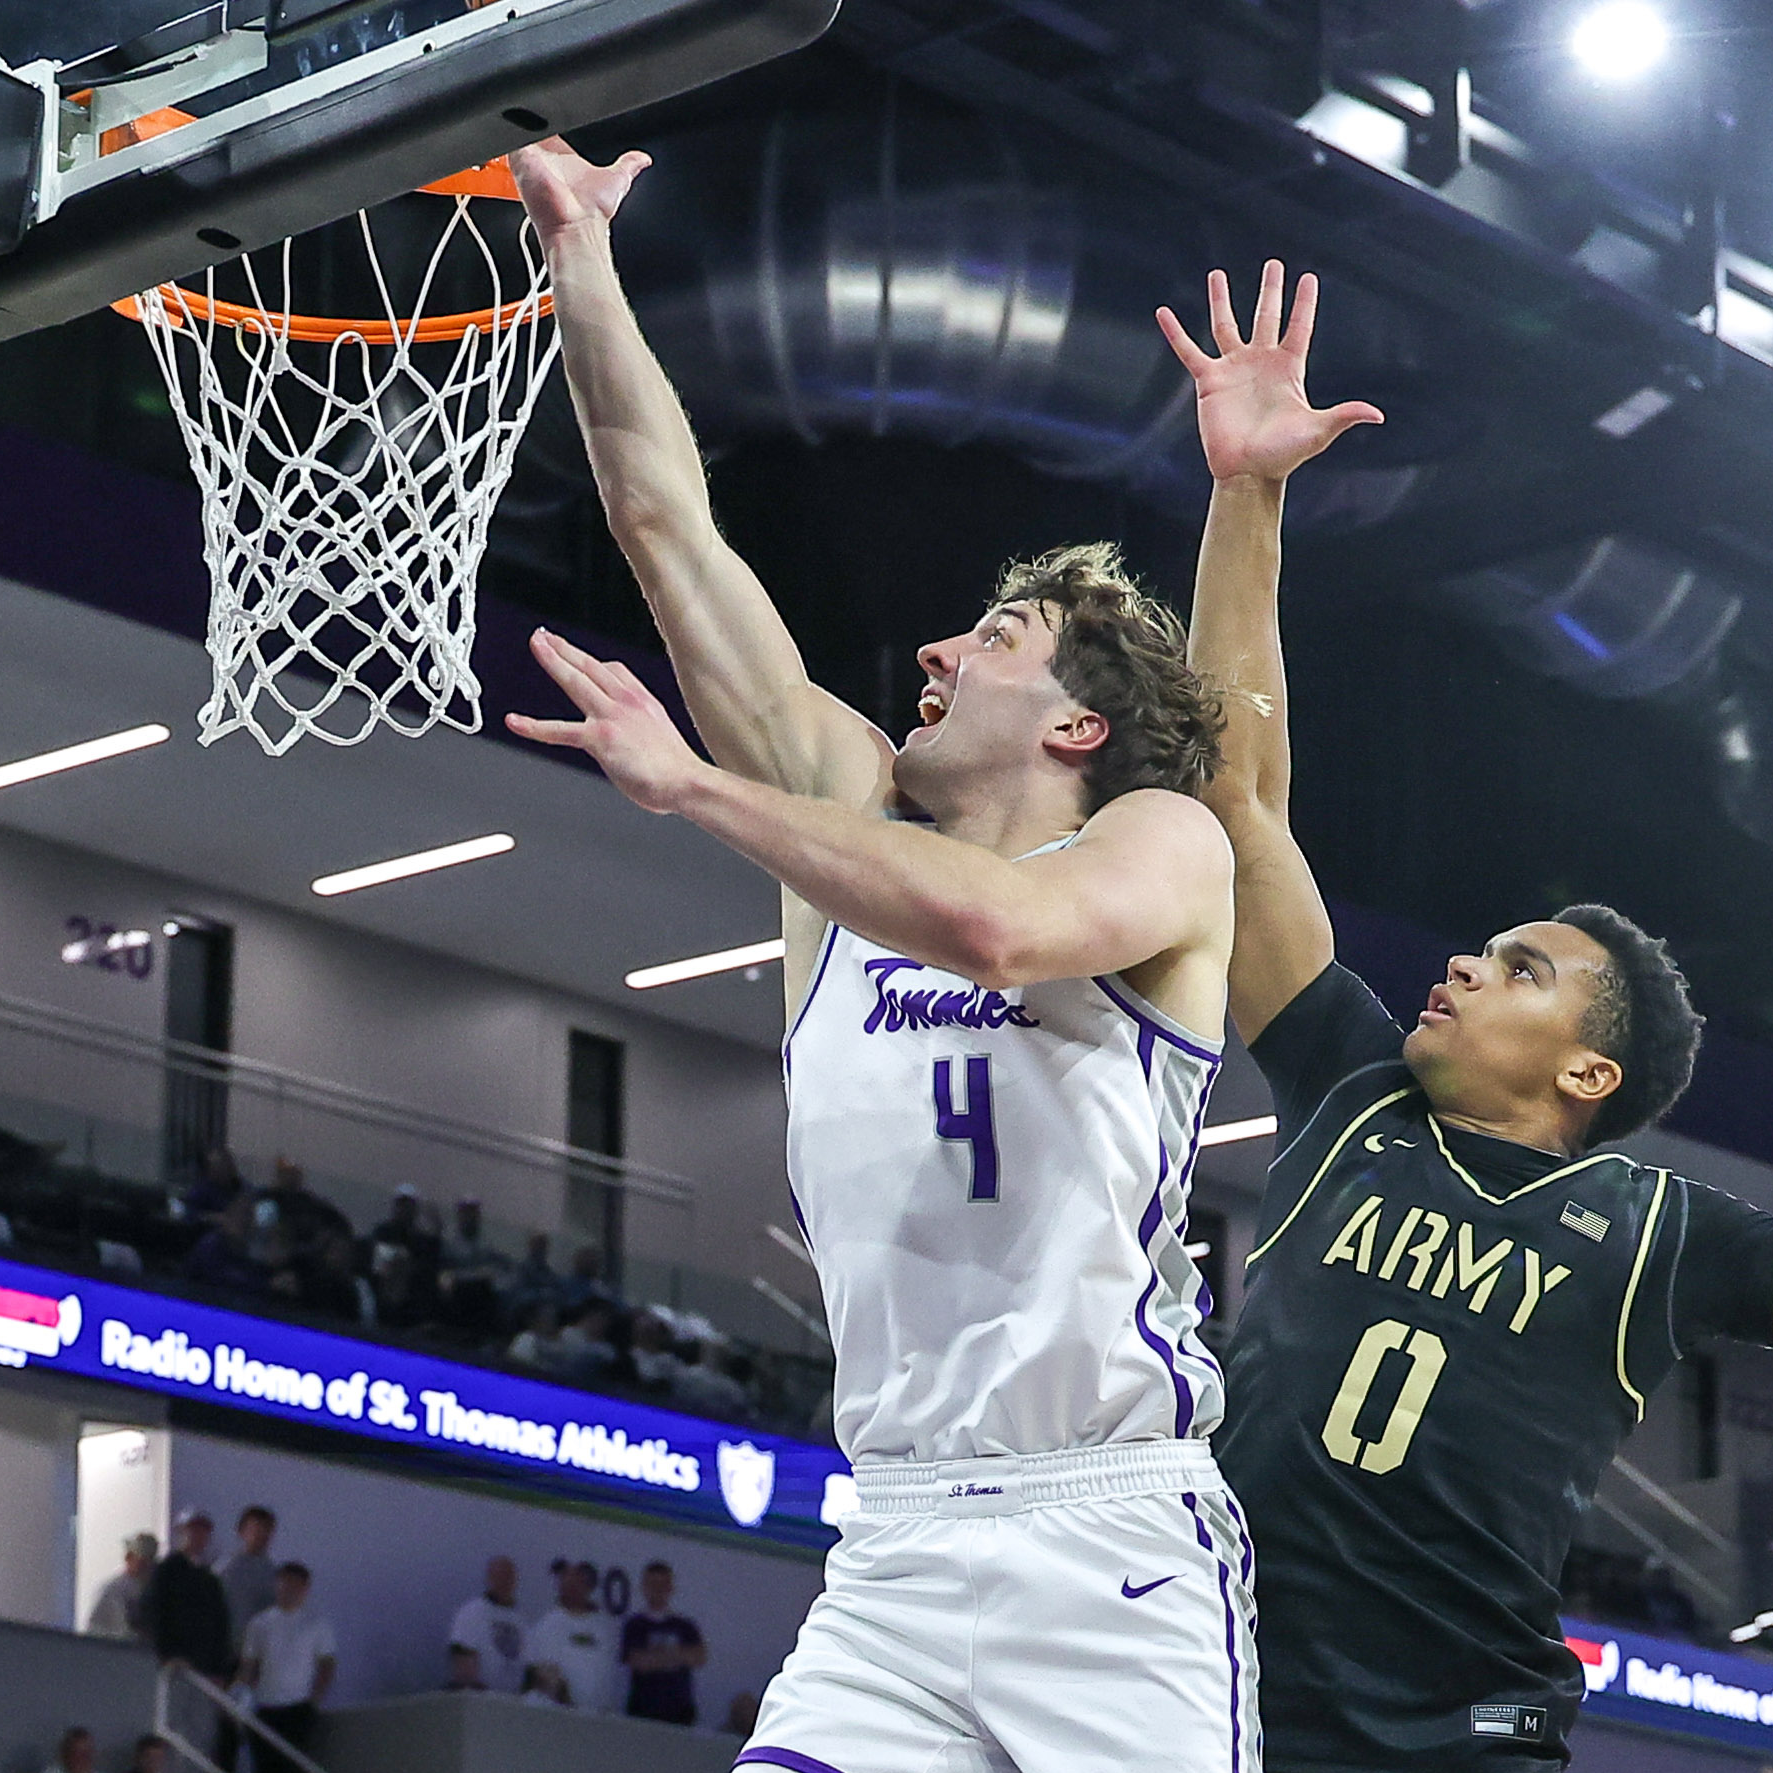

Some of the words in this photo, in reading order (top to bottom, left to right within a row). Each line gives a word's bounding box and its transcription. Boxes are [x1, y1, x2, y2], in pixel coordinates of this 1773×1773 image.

[864, 957, 1041, 1035] Tommies
[931, 1053, 1000, 1203] 4
[1322, 1193, 1572, 1335] ARMY
[101, 1318, 211, 1385] Radio
[213, 1344, 323, 1410] Home
[325, 1371, 369, 1419] of
[368, 1379, 417, 1432] St.
[419, 1389, 557, 1462] Thomas
[557, 1421, 701, 1492] Athletics
[1320, 1318, 1449, 1477] 0
[964, 1482, 1004, 1497] Thomas
[1524, 1715, 1538, 1732] M
[1627, 1657, 1692, 1707] Radio
[1692, 1672, 1758, 1723] Home
